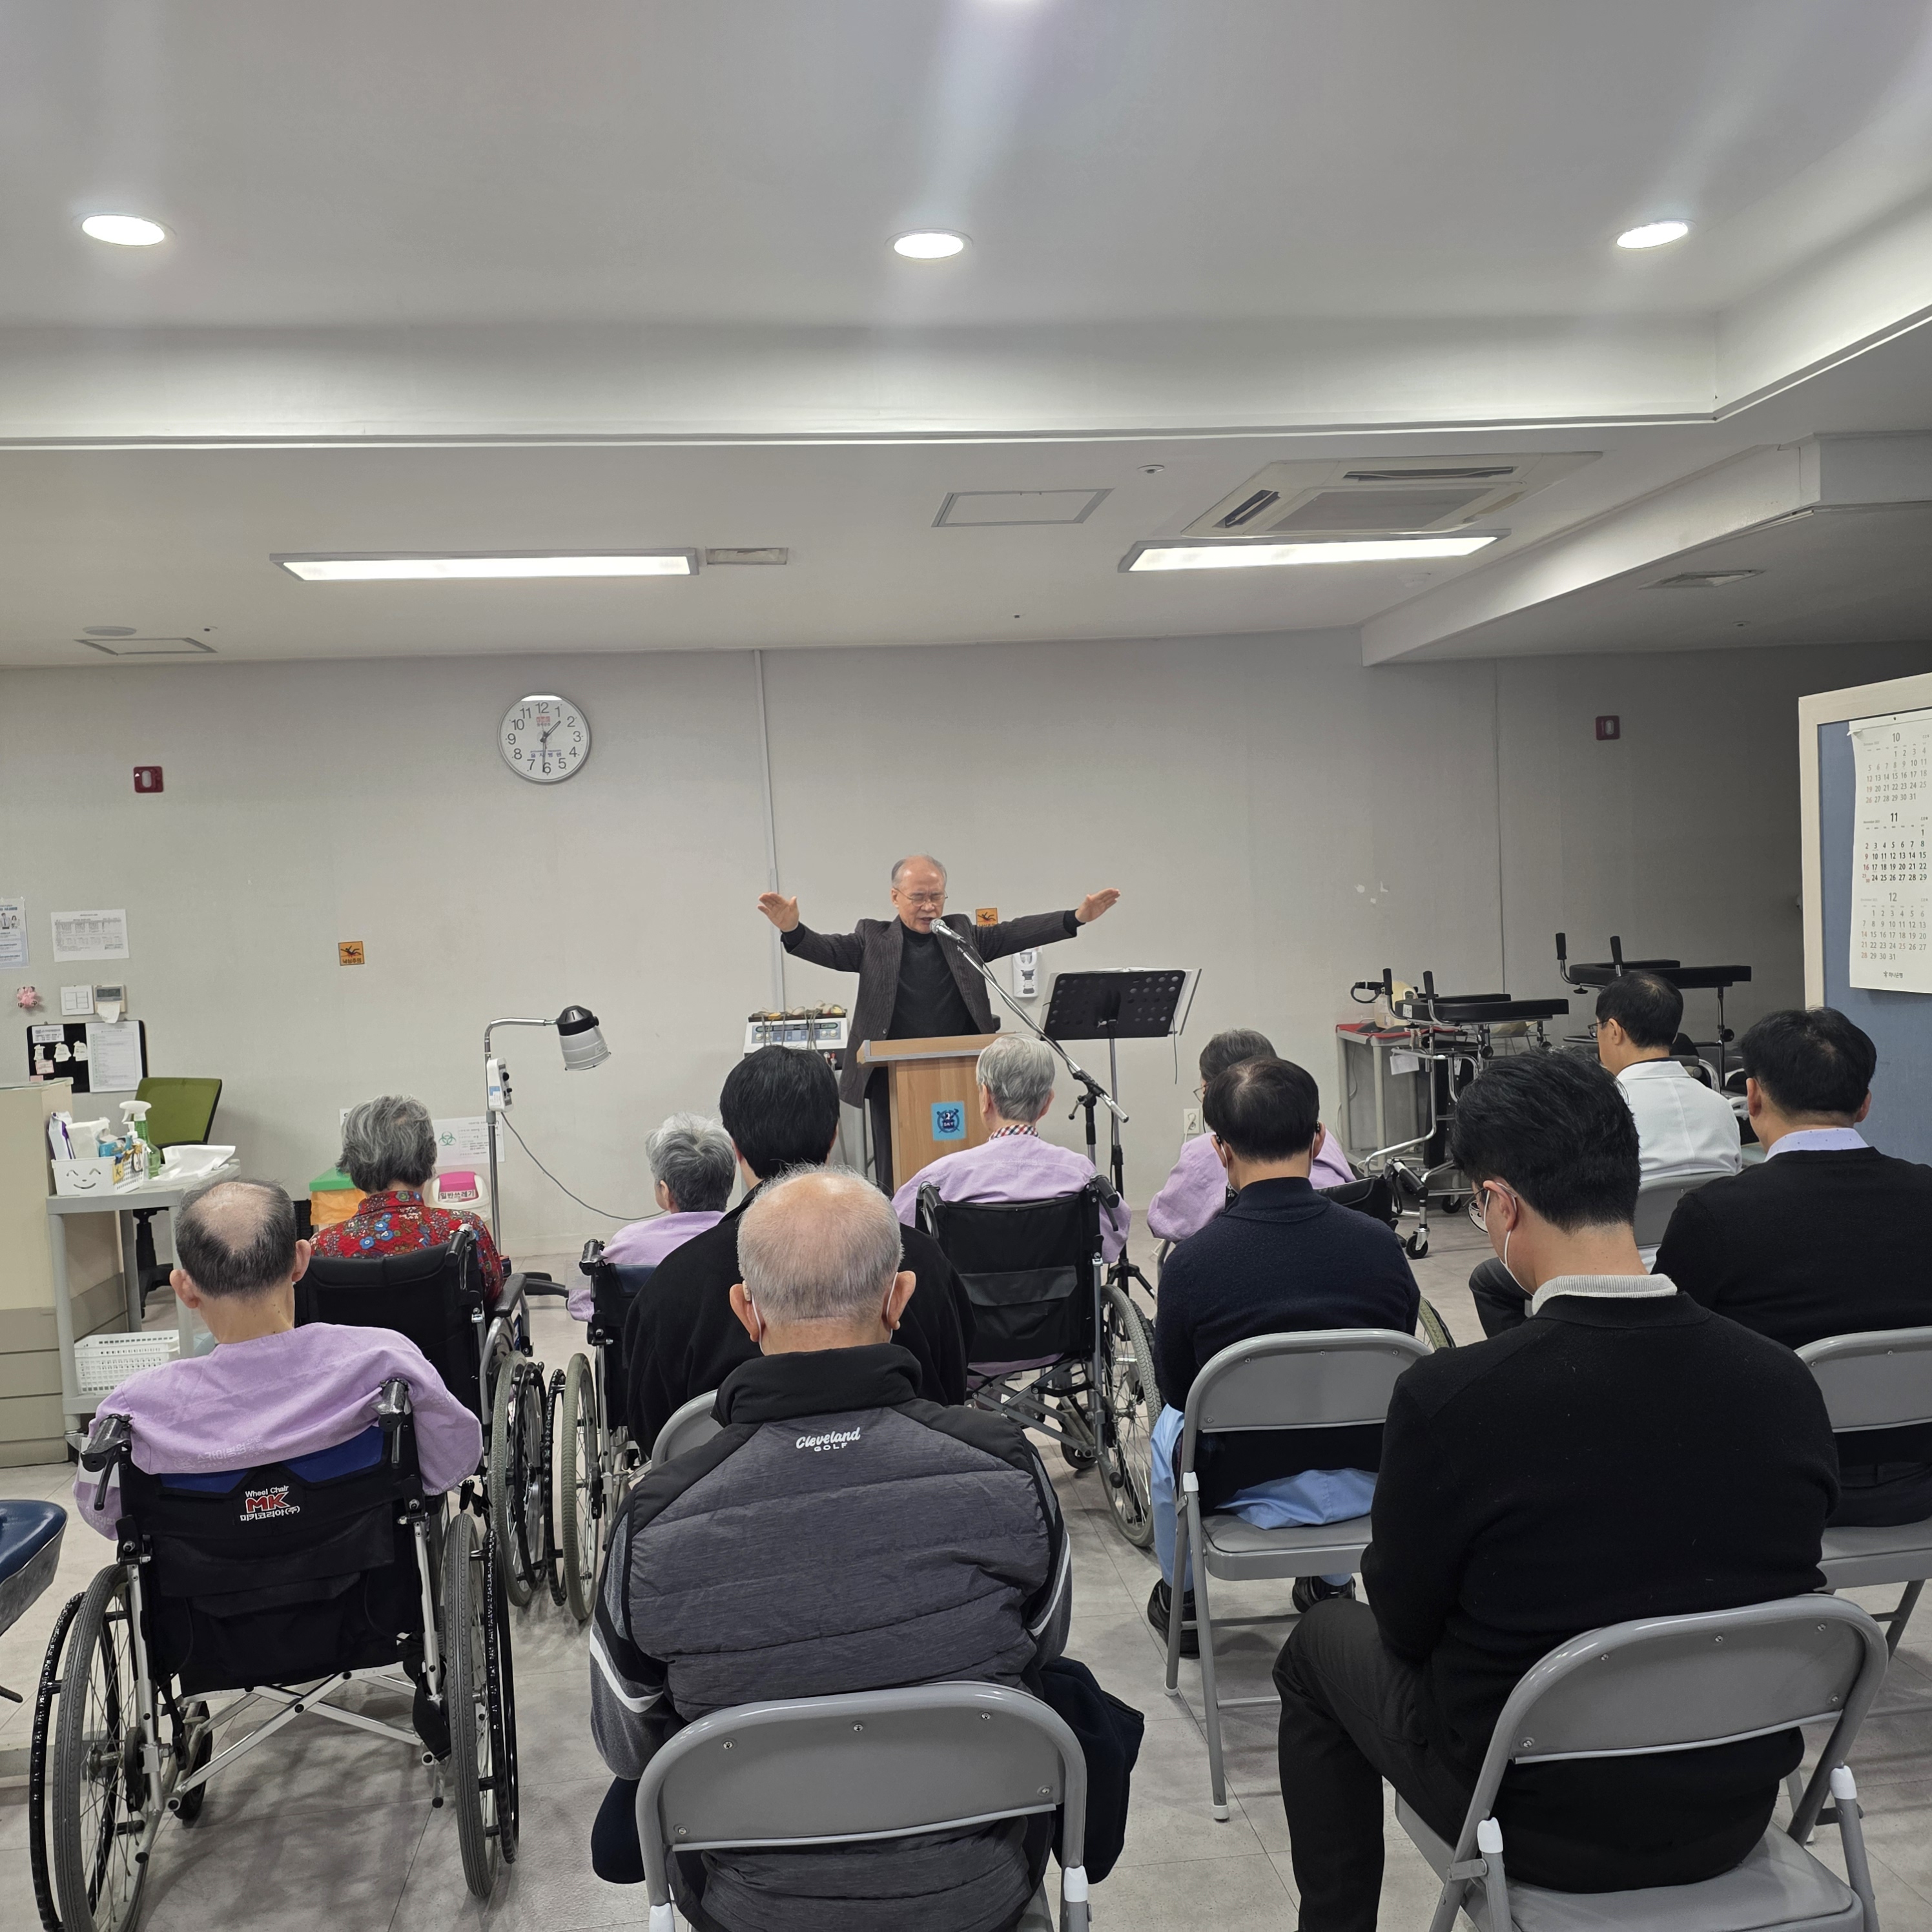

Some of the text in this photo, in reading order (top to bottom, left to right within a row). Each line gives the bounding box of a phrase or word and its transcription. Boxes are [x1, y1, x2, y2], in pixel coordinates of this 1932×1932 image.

[520, 708, 531, 719] 11
[535, 702, 550, 714] 12
[555, 706, 560, 717] 1
[511, 719, 524, 730] 10
[567, 716, 575, 727] 2
[508, 733, 516, 745] 9
[573, 731, 581, 742] 3
[1893, 732, 1900, 742] 10
[514, 748, 522, 759] 8
[569, 746, 577, 757] 4
[527, 759, 535, 770] 7
[544, 763, 551, 774] 6
[559, 758, 567, 769] 5
[1891, 812, 1898, 822] 11
[1889, 892, 1897, 901] 12
[440, 1190, 474, 1199] 일반쓰레기
[796, 1426, 861, 1449] Cleveland
[814, 1443, 848, 1452] GOLF
[245, 1485, 289, 1497] Wheel Chair
[245, 1492, 291, 1514] MK
[240, 1506, 300, 1521] 미키코리아(주)
